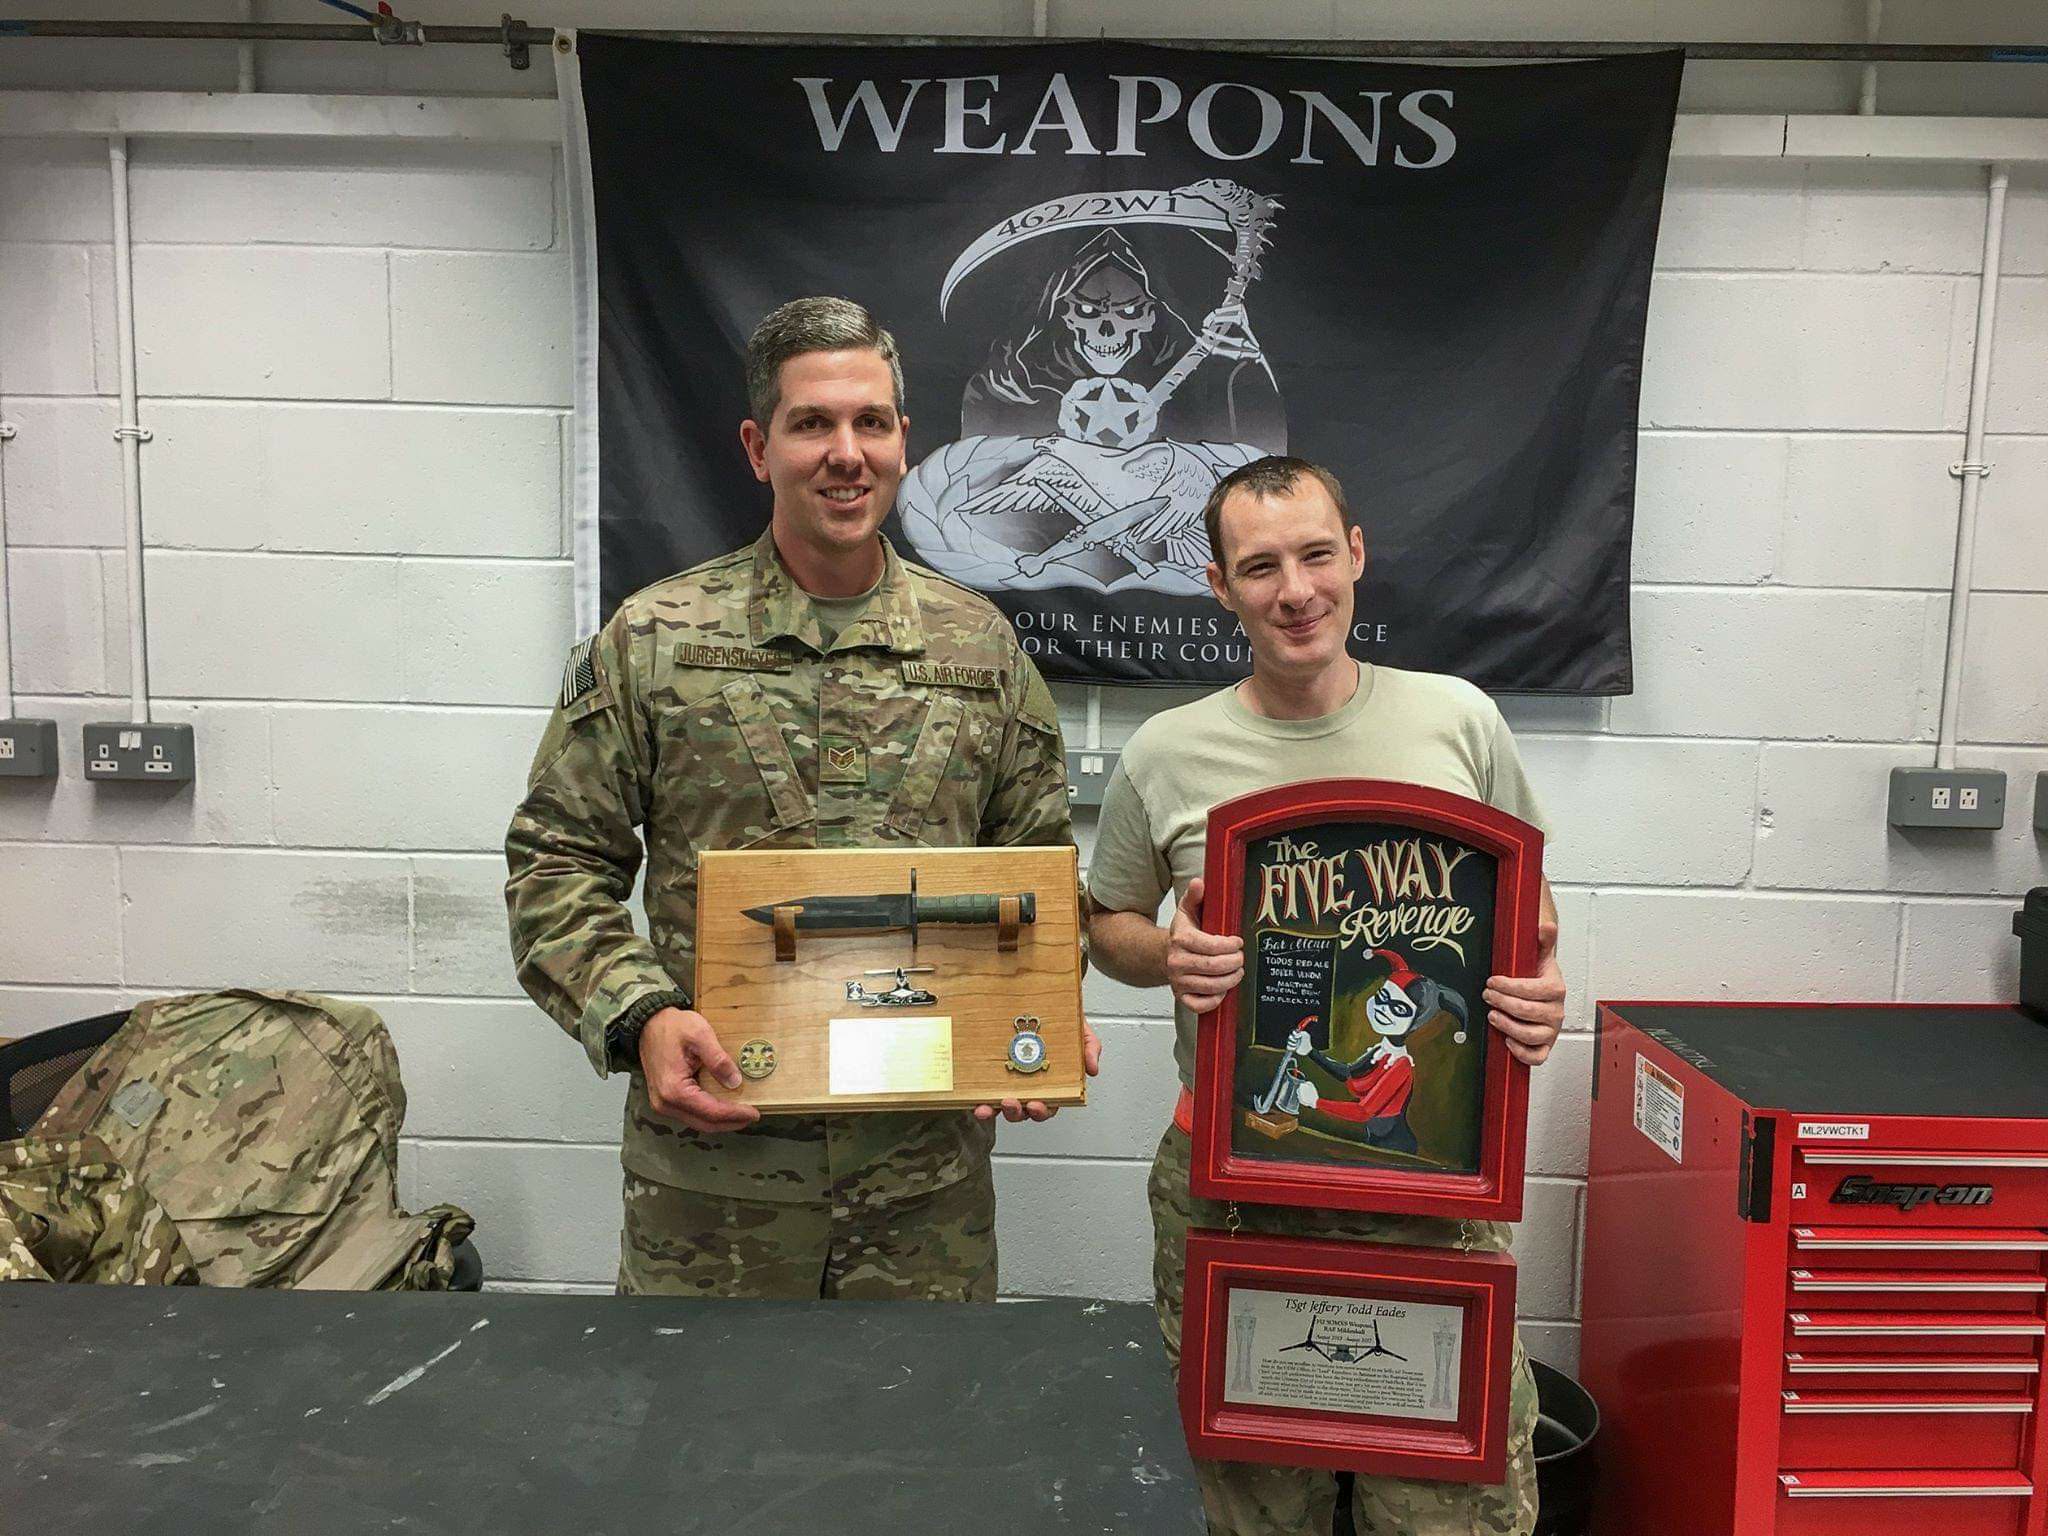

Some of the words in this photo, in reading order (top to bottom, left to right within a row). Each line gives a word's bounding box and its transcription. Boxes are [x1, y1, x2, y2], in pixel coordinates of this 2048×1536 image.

[793, 73, 1457, 169] WEAPONS
[1015, 611, 1078, 631] OUR
[1093, 615, 1217, 636] ENEMIES
[1022, 636, 1062, 655] OR
[1075, 640, 1167, 660] THEIR
[933, 665, 953, 684] AIR
[954, 666, 995, 687] FORCE
[1267, 836, 1321, 862] The
[1256, 850, 1355, 927] FIVE
[1354, 837, 1478, 905] WAY
[1339, 901, 1475, 967] Revenge
[1313, 961, 1329, 969] ALE
[1793, 1186, 1804, 1197] A
[1829, 1175, 1993, 1210] Snap-on
[1285, 1299, 1307, 1313] TSgt
[1308, 1300, 1343, 1316] Jeffery
[1346, 1303, 1373, 1315] Todd
[1375, 1306, 1407, 1318] Eades
